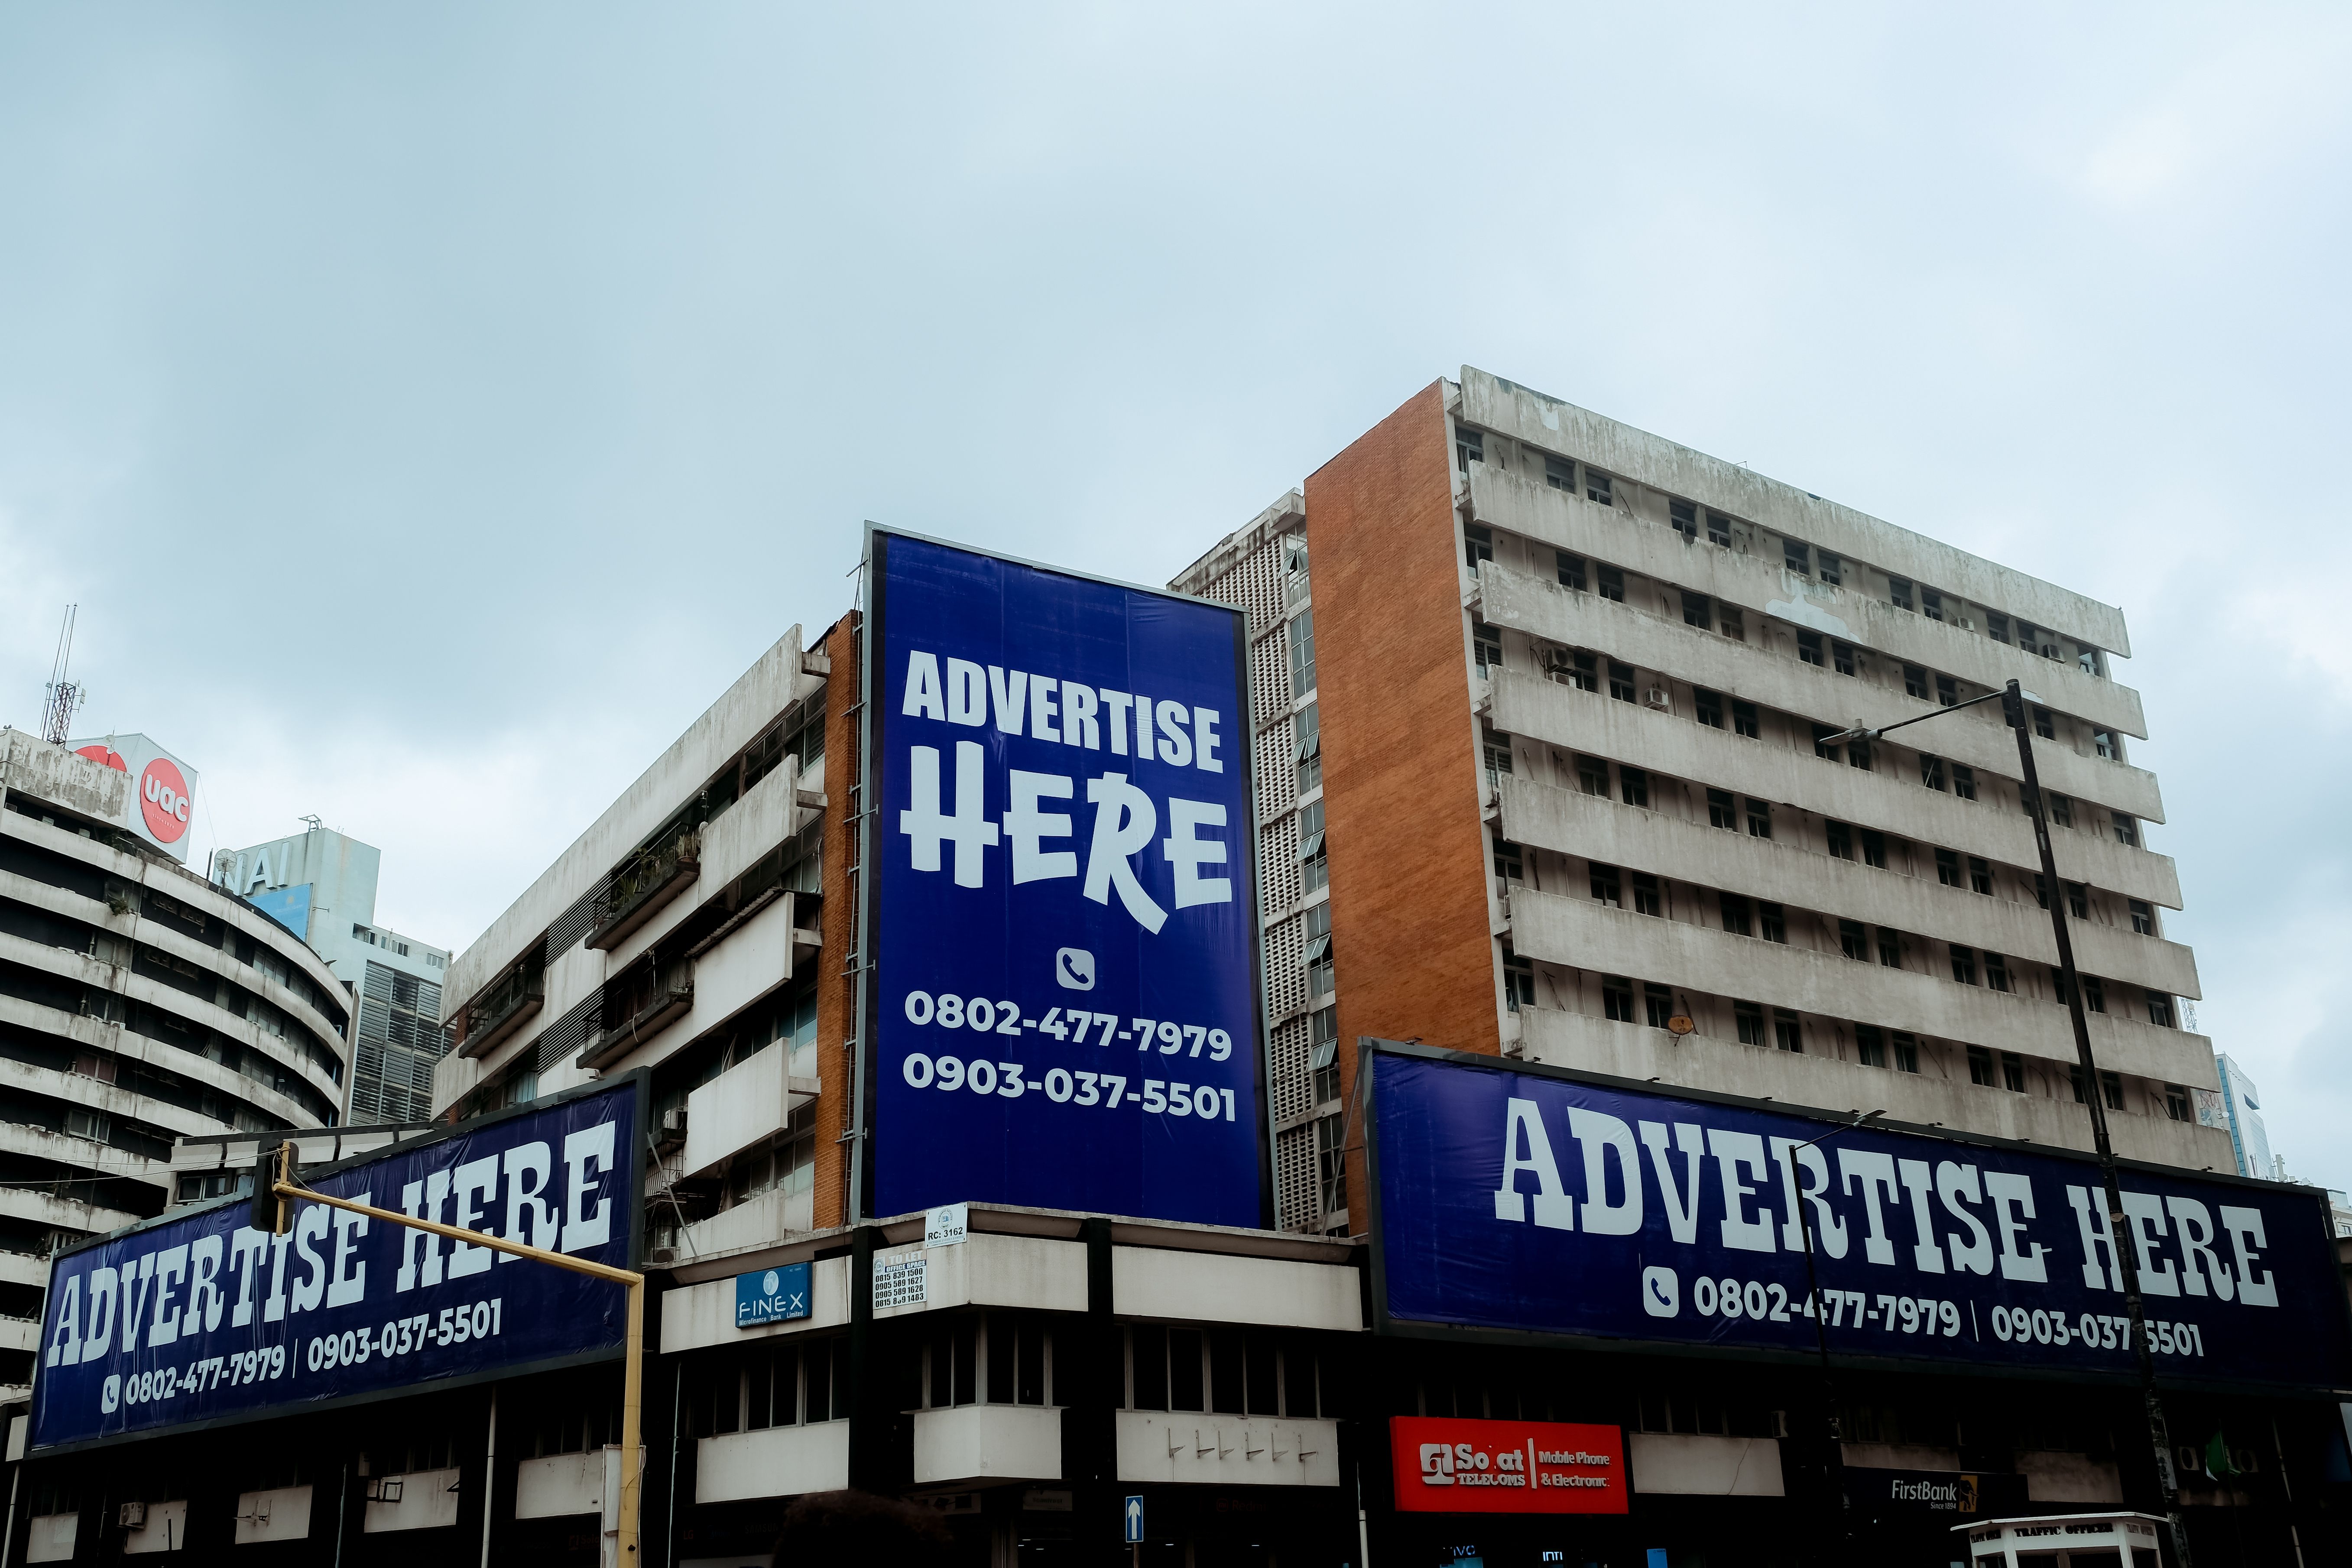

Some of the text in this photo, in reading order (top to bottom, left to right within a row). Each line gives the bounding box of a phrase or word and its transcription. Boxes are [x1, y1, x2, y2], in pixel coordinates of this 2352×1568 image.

[902, 650, 1223, 774] ADVERTISE
[900, 741, 1232, 935] HERE
[905, 991, 1231, 1061] 0802-477-7979
[903, 1053, 1235, 1121] 0903-037-5501
[1495, 1097, 2279, 1307] ADVERTISE HERE
[928, 1227, 963, 1240] RC: 3162
[46, 1120, 615, 1367] ADVERTISE HERE
[886, 1264, 905, 1272] OFFICE
[906, 1260, 926, 1269] SPACE
[889, 1251, 923, 1265] TO LET
[876, 1268, 923, 1282] 0815 839 1500
[876, 1276, 923, 1291] 0905 589 1627
[876, 1285, 923, 1299] 0905 589 1628
[739, 1292, 803, 1318] FINEX
[876, 1299, 891, 1308] 0815
[739, 1317, 767, 1326] Microfinance
[787, 1310, 803, 1318] Limited
[1694, 1276, 2203, 1356] 0802-477-7979 0903-0375501
[126, 1298, 501, 1404] 0802-477-7979 0903-037-5501
[1455, 1443, 1524, 1471] Soat
[1538, 1451, 1612, 1465] Mobile Phone
[1541, 1473, 1610, 1487] & Electronic
[1892, 1480, 1957, 1501] FirstBank
[745, 1522, 779, 1534] SAMSUN
[2014, 1526, 2061, 1537] TRAFFIC
